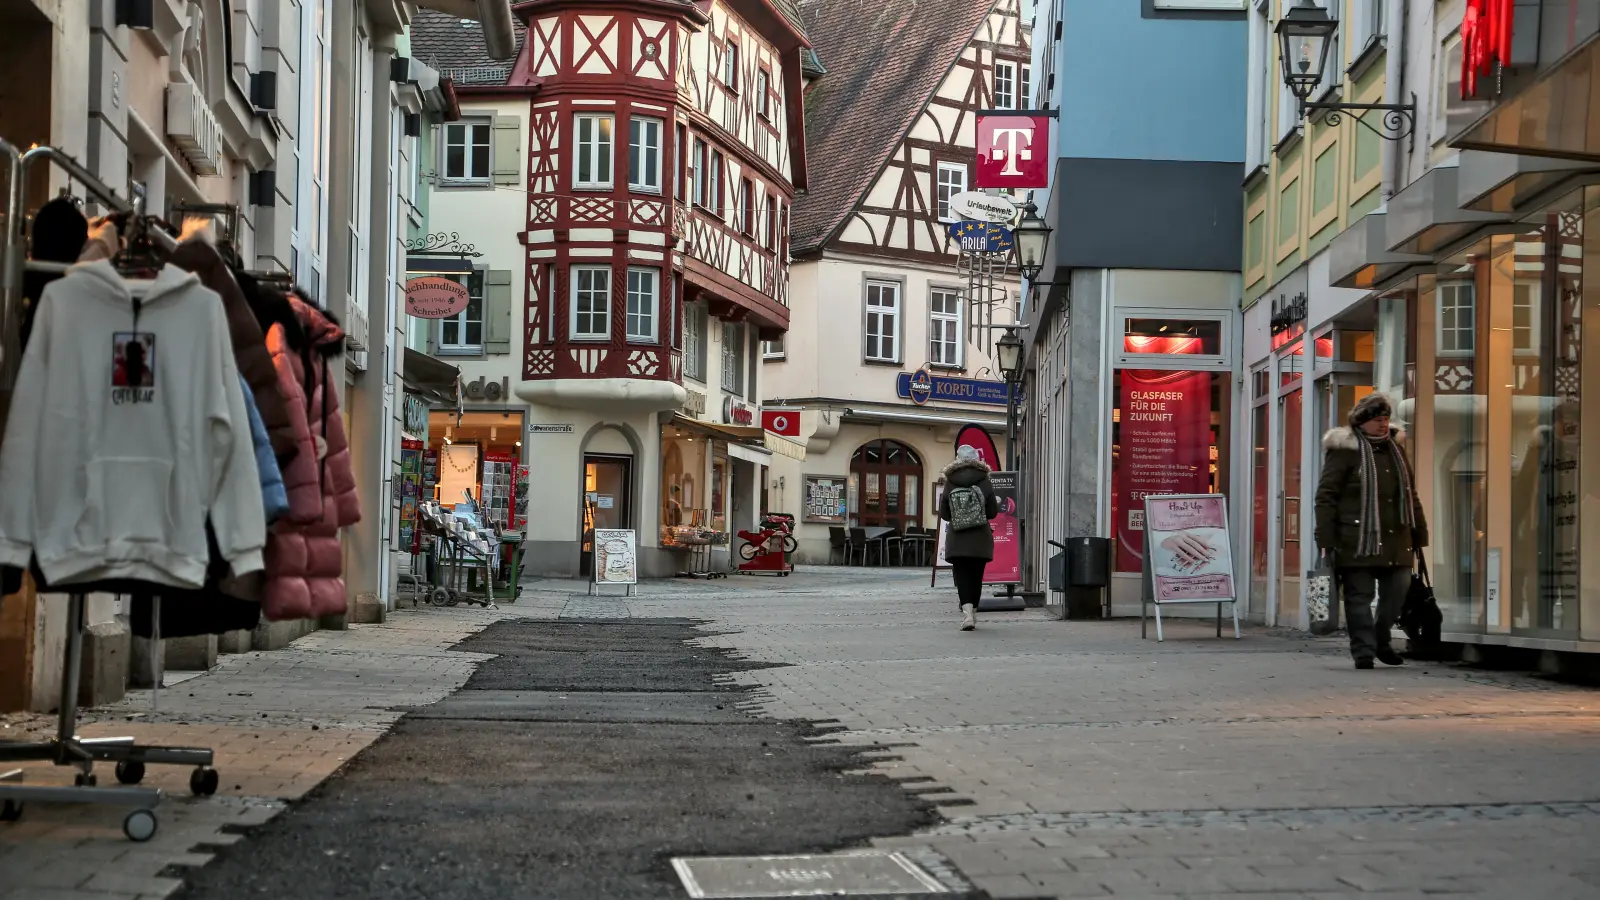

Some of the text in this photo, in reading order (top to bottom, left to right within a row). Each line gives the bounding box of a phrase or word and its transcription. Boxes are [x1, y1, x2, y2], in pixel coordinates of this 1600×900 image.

[993, 128, 1031, 176] T
[962, 236, 986, 250] ARILA
[405, 281, 467, 299] uchhandlung
[413, 305, 452, 316] Schreiber
[461, 375, 509, 400] del
[912, 382, 931, 390] Tucher
[936, 381, 974, 397] KORFU
[1130, 391, 1184, 401] GLASFASER
[1130, 400, 1166, 411] FÜR DIE
[1130, 412, 1174, 421] ZUKUNFT
[1131, 512, 1144, 520] JET
